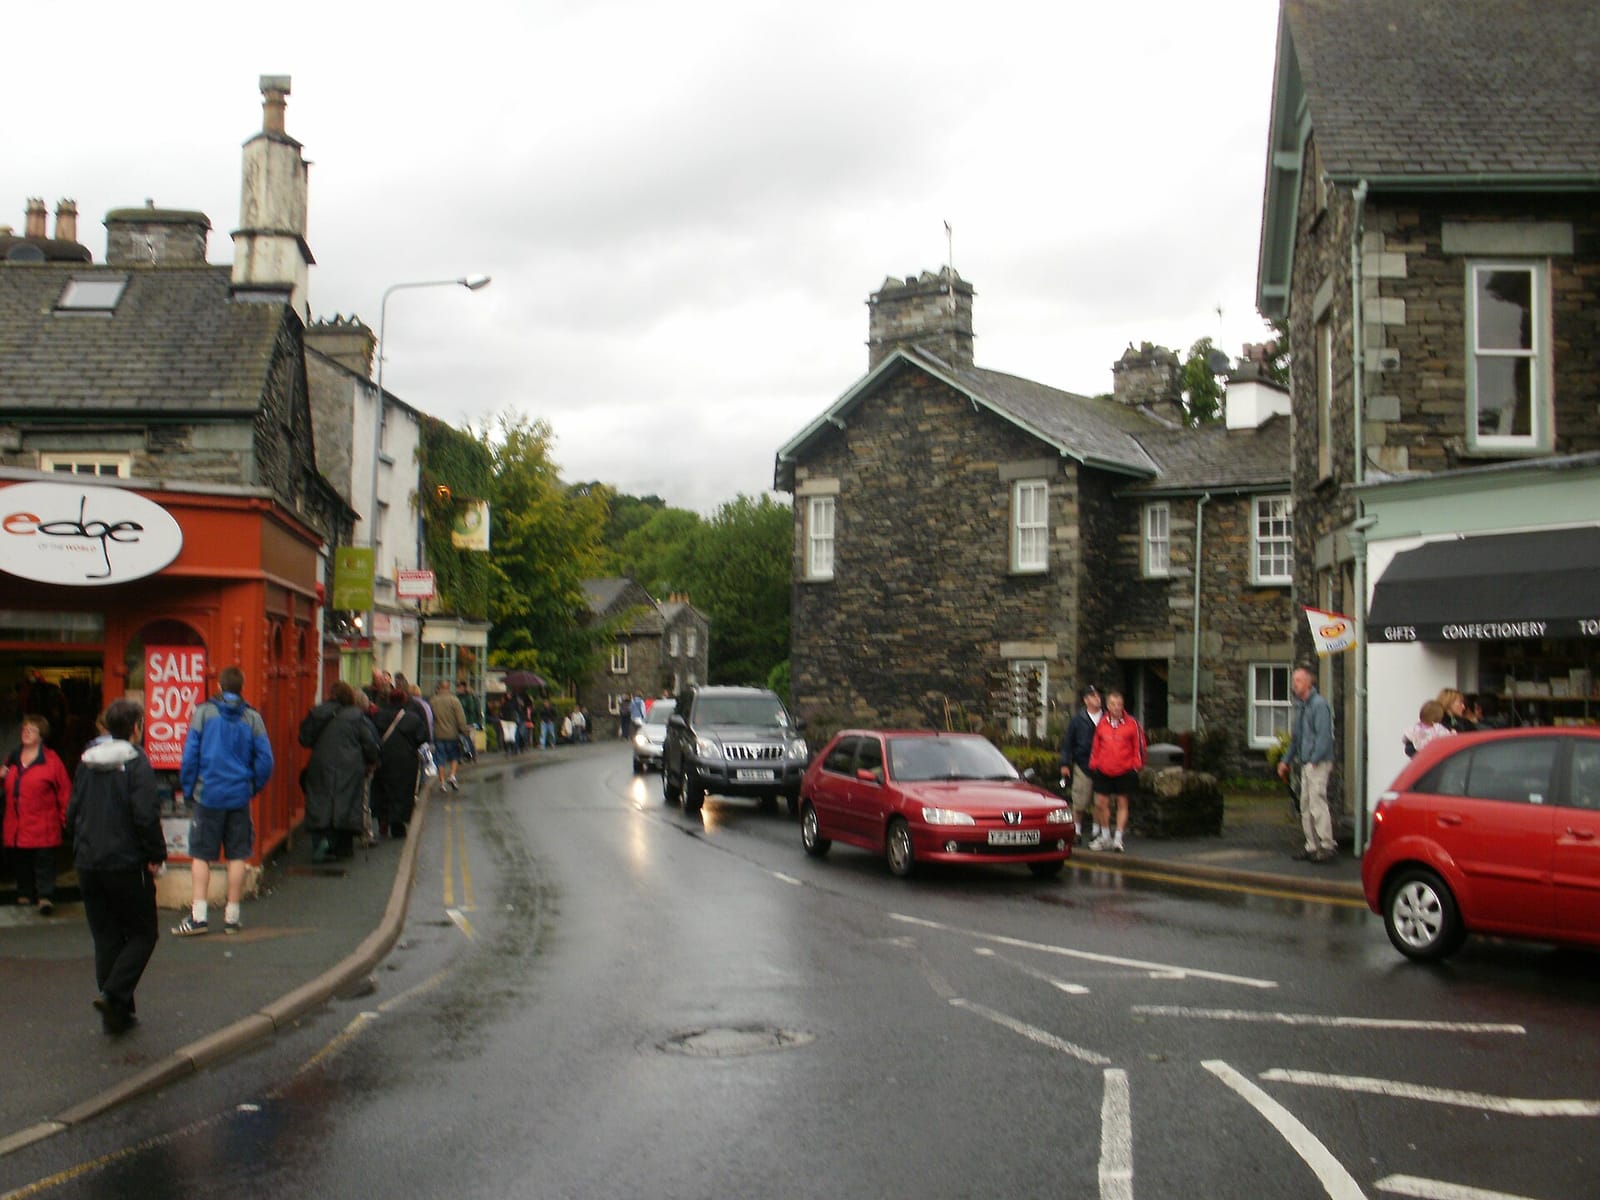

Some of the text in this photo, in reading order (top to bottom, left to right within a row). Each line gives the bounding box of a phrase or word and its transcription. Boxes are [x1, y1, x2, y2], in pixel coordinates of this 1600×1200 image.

[2, 494, 144, 578] edge
[1384, 619, 1600, 641] GIFTS CONFECTIONERY TO
[149, 652, 204, 682] SALE
[150, 686, 199, 720] 50%
[148, 721, 188, 741] OF
